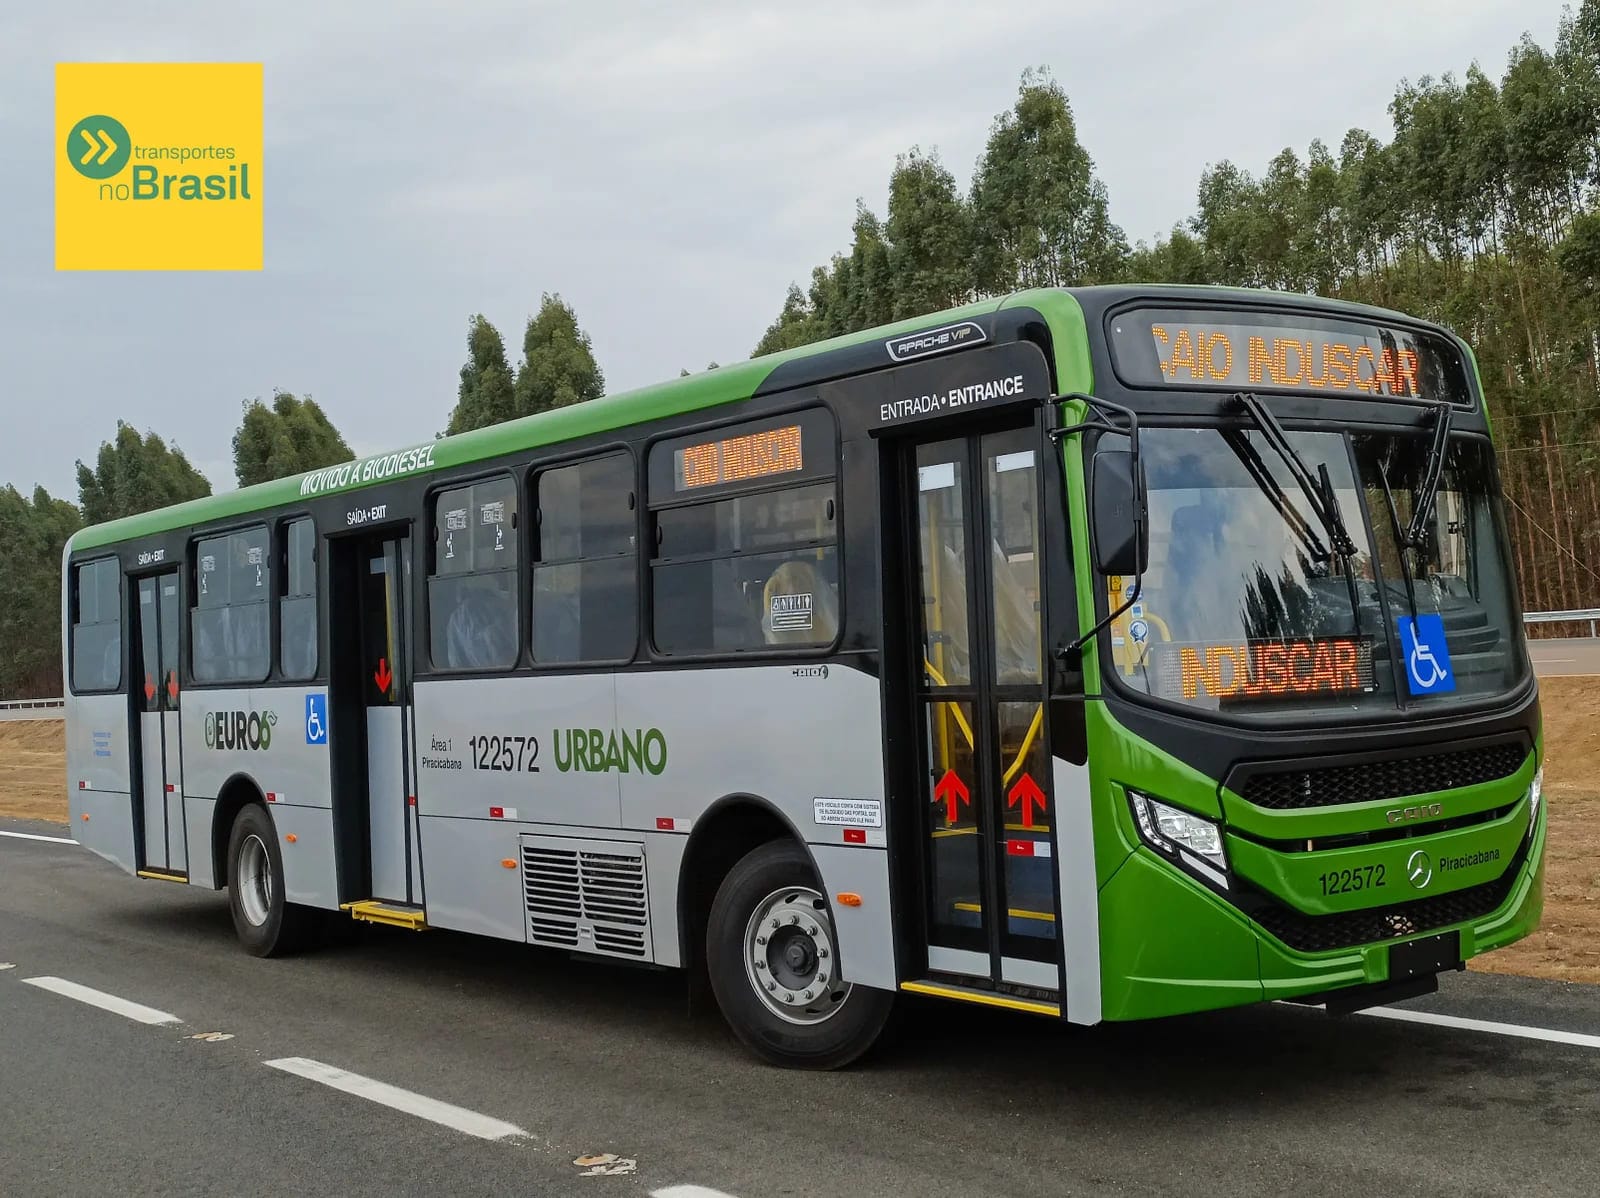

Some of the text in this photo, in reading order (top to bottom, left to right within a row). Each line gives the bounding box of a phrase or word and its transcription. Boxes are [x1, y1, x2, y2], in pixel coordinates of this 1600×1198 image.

[898, 327, 971, 354] APACHE VIP
[1248, 335, 1418, 395] INDUSCAR
[880, 375, 1024, 421] ENTRADA ENTRANCE
[300, 445, 435, 496] MOVIDO A BIODIESEL
[346, 504, 387, 526] SAÍDA EXIT
[1180, 641, 1359, 699] INDUSCAR
[431, 733, 452, 752] Área 1
[469, 735, 541, 773] 122572
[553, 727, 668, 776] URBANO
[422, 756, 462, 770] Piracicabana
[1386, 803, 1443, 824] CAIO
[1440, 848, 1500, 872] Piracicabana
[1319, 863, 1386, 897] 122572
